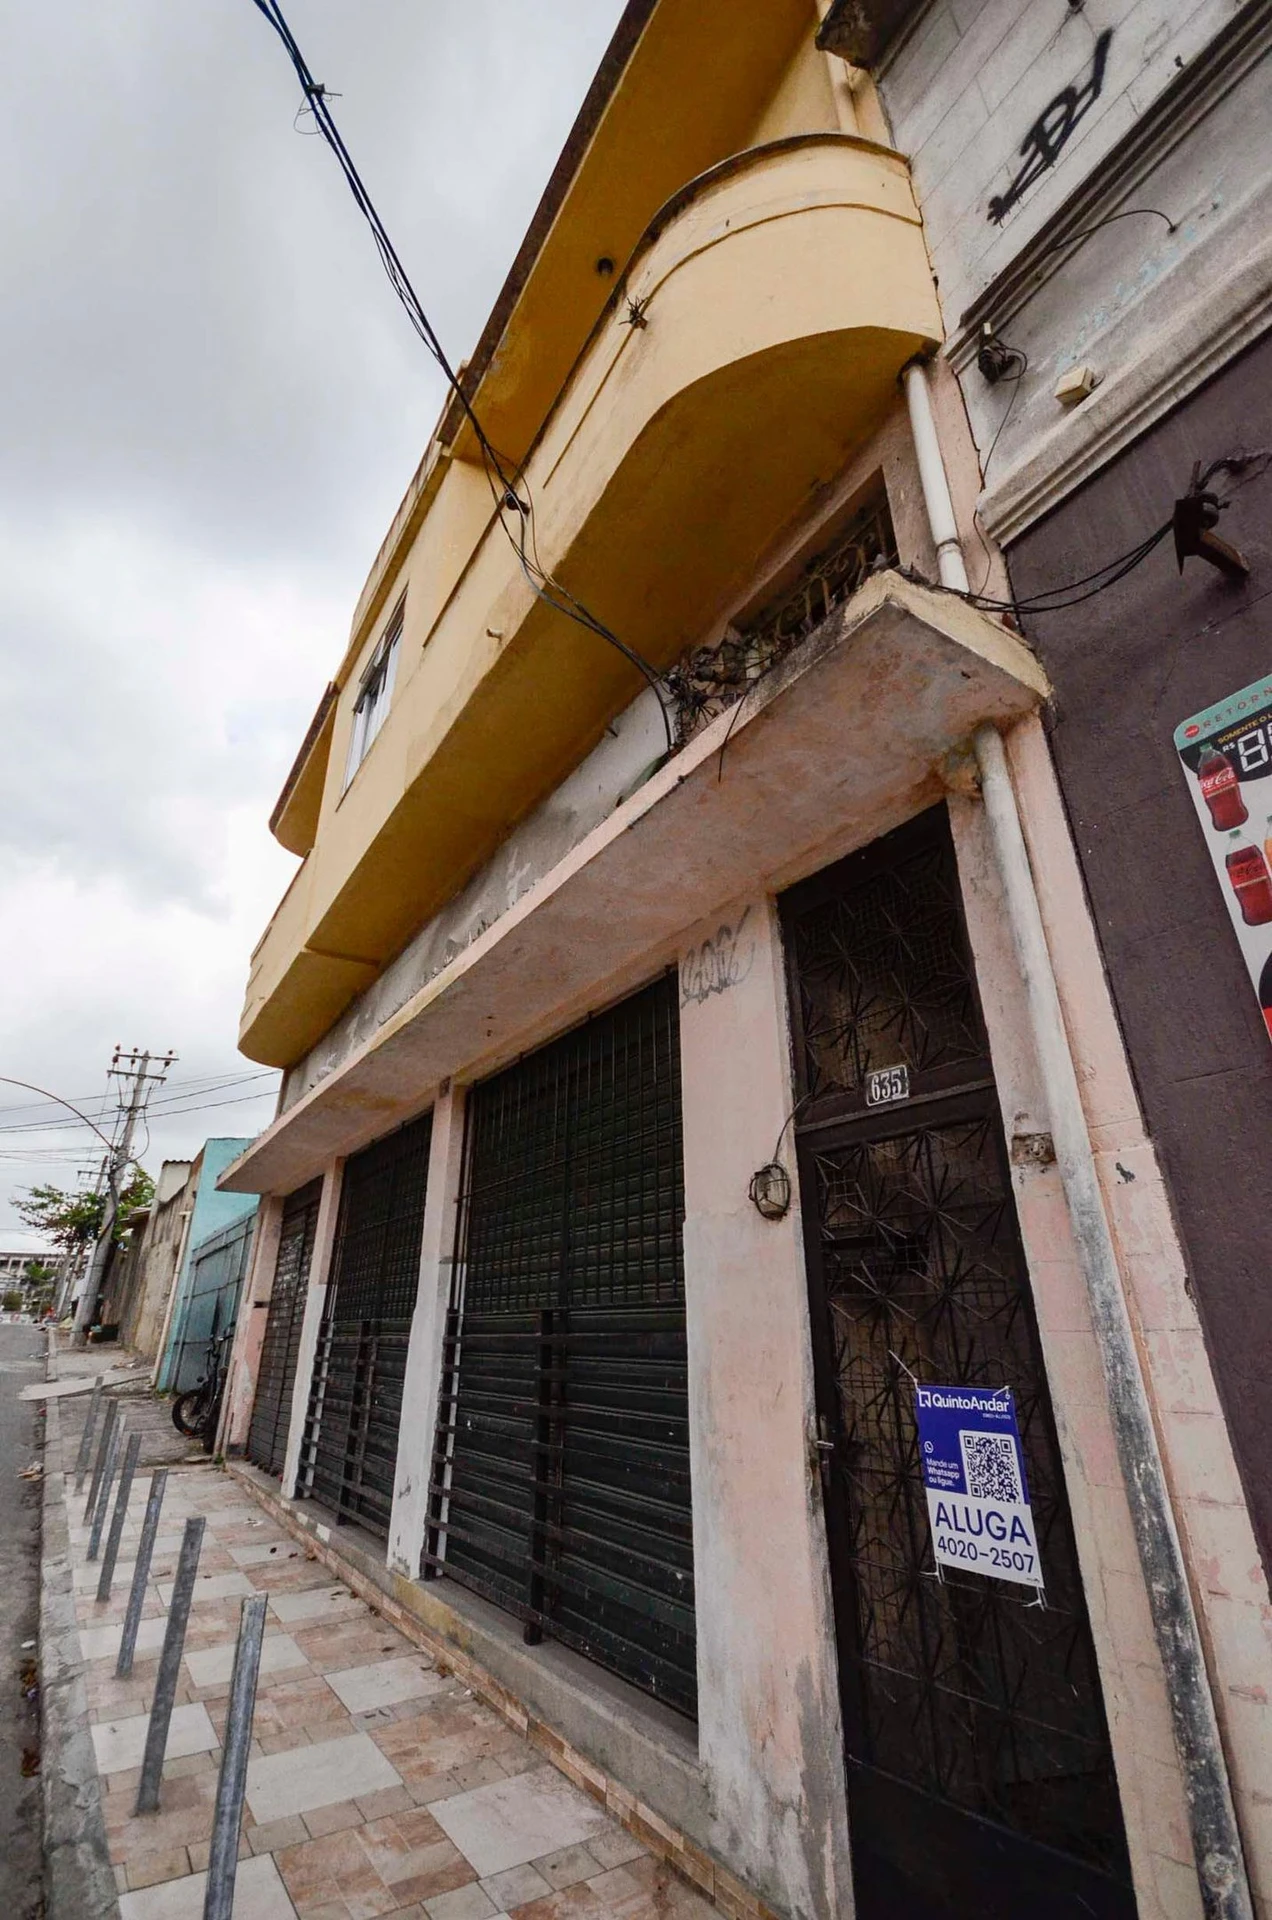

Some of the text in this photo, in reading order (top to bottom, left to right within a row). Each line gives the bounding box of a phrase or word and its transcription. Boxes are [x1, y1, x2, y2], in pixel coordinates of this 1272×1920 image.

[1217, 720, 1259, 744] SOMENTE
[1222, 742, 1236, 752] R$
[871, 1069, 902, 1101] 635
[932, 1393, 1010, 1412] QuintoAndar
[935, 1501, 1031, 1546] ALUGA
[937, 1535, 1034, 1574] 4020-2507
